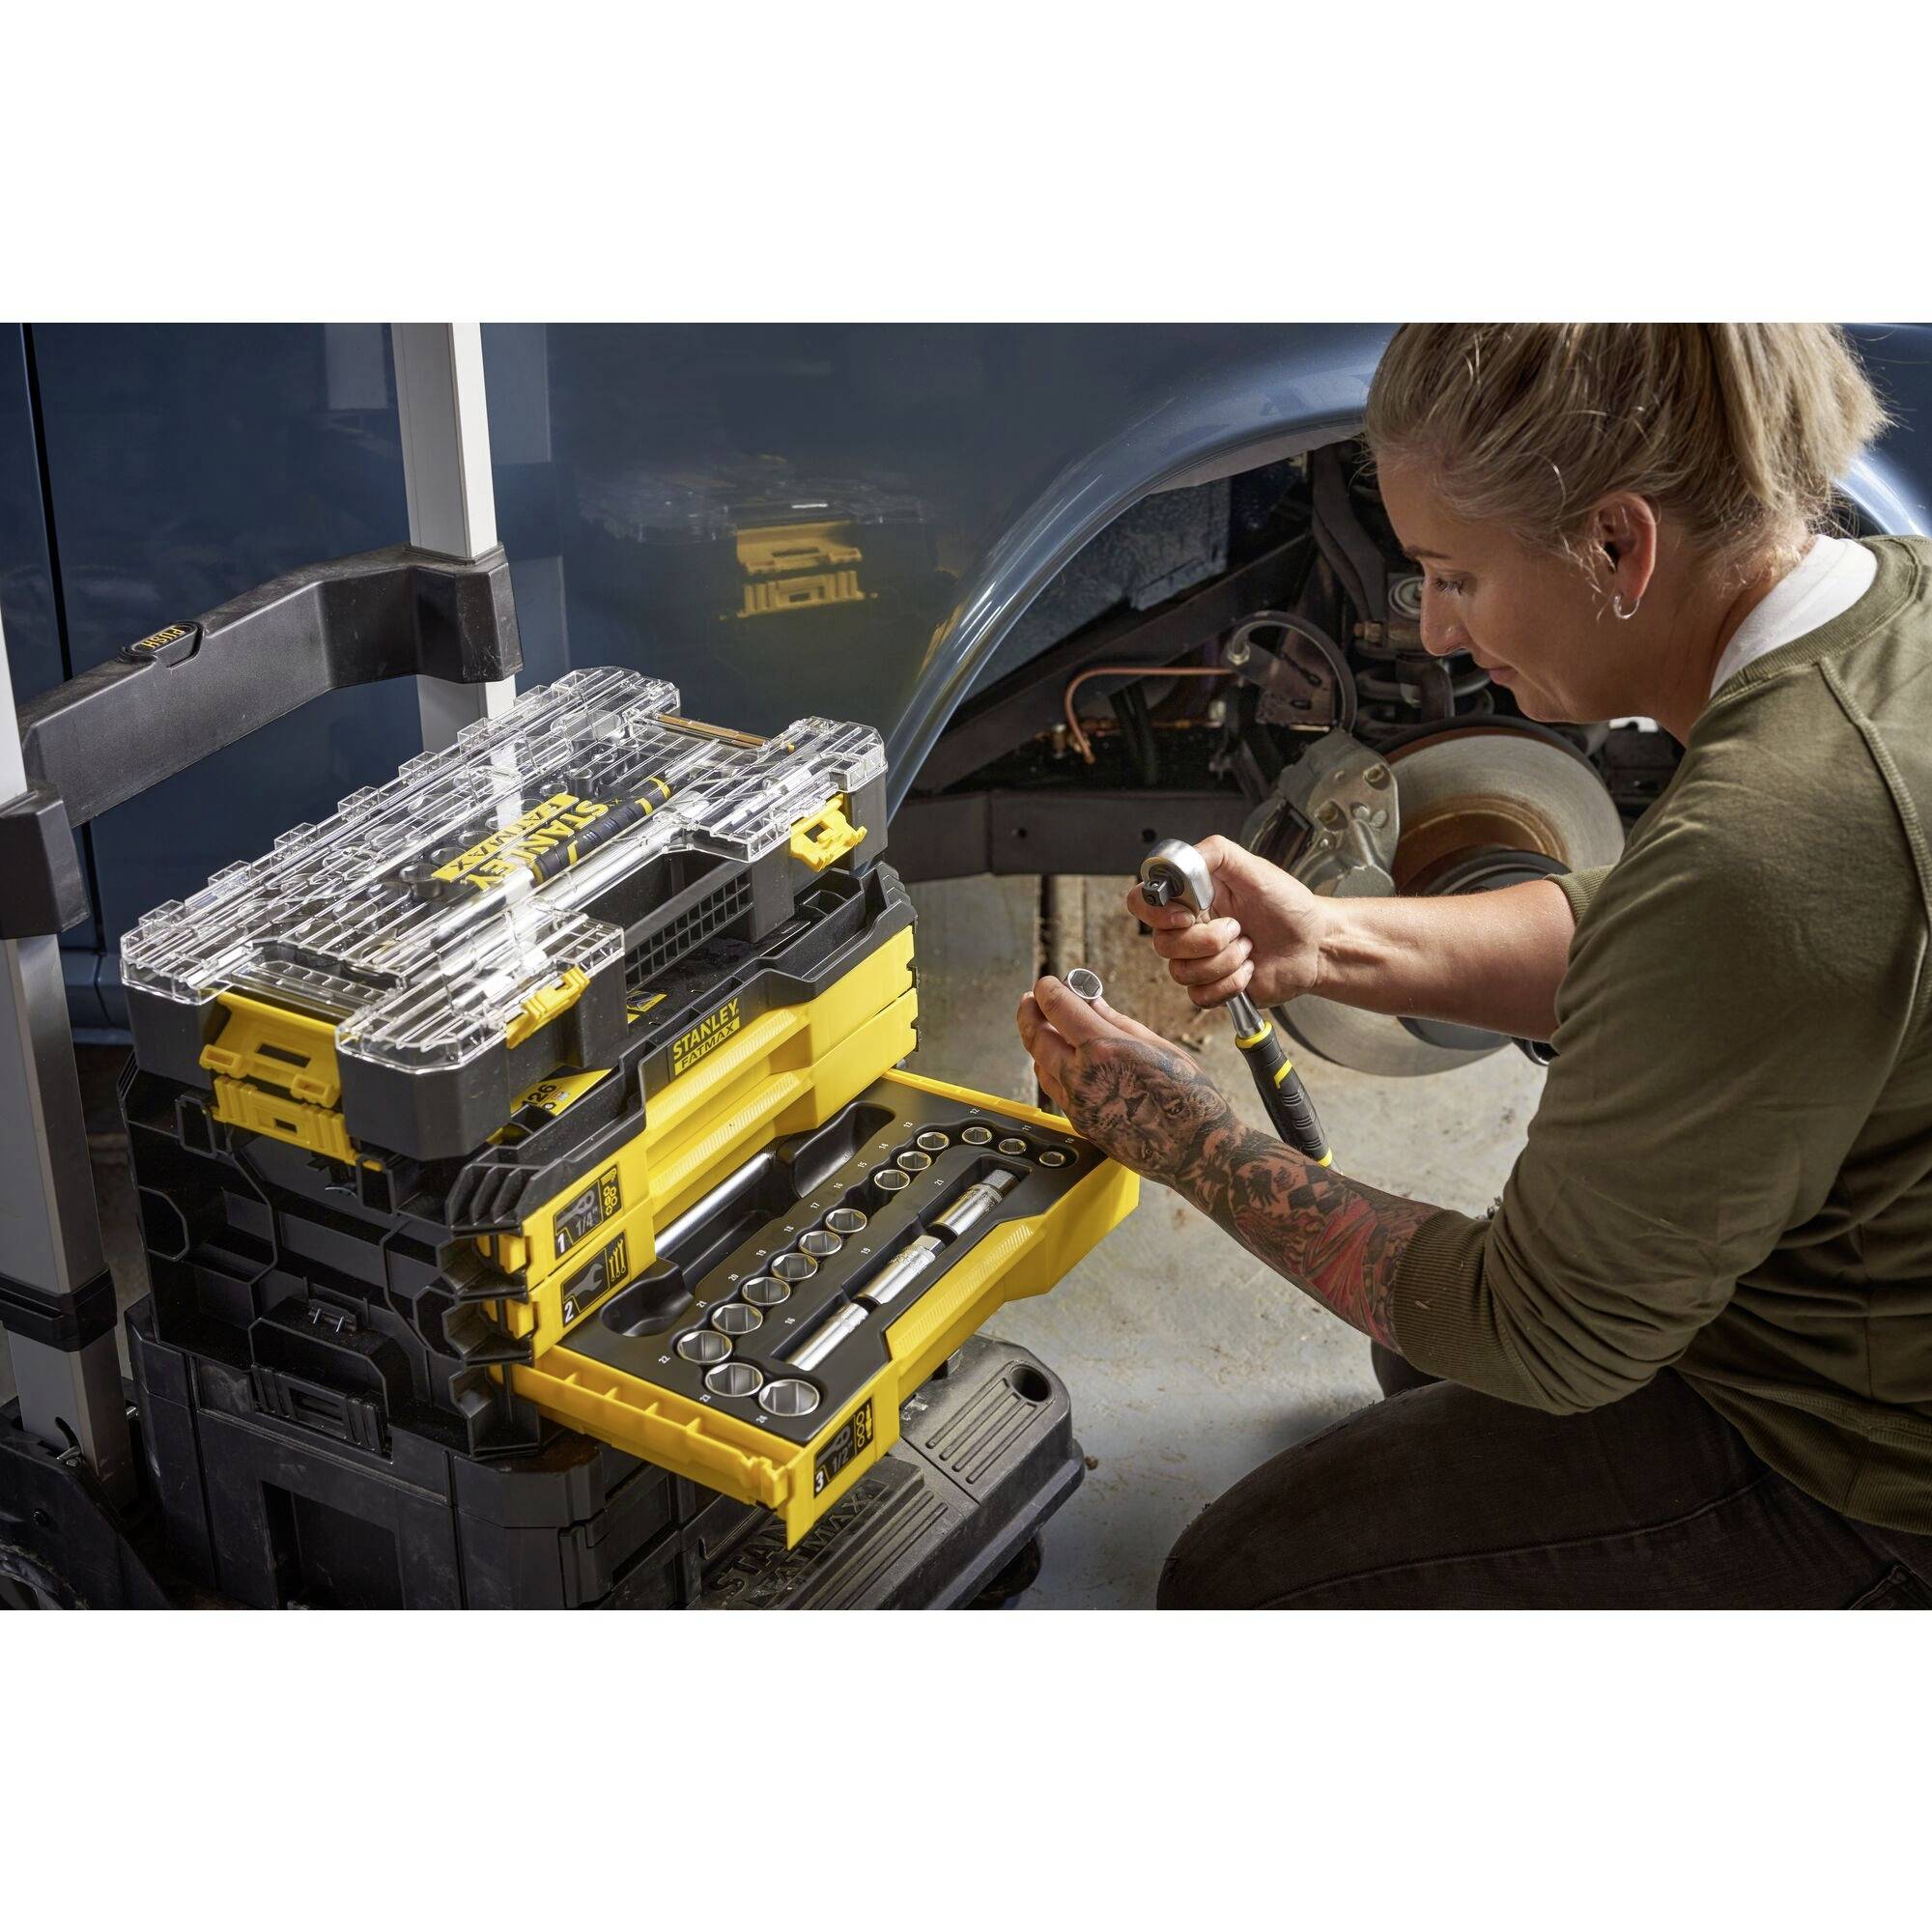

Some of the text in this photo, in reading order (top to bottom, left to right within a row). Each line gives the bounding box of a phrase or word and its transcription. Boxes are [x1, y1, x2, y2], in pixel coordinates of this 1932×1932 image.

[141, 627, 186, 649] PUSH
[447, 799, 564, 873] FATMAX
[466, 799, 610, 892] STANLEY
[672, 997, 740, 1061] STANLEY
[679, 1020, 737, 1070] FATMAX
[575, 1206, 599, 1236] 1/4"
[556, 1233, 566, 1254] 1
[563, 1300, 575, 1324] 2
[659, 1355, 671, 1364] 22
[832, 1439, 854, 1473] 1/2"
[815, 1469, 825, 1493] 3
